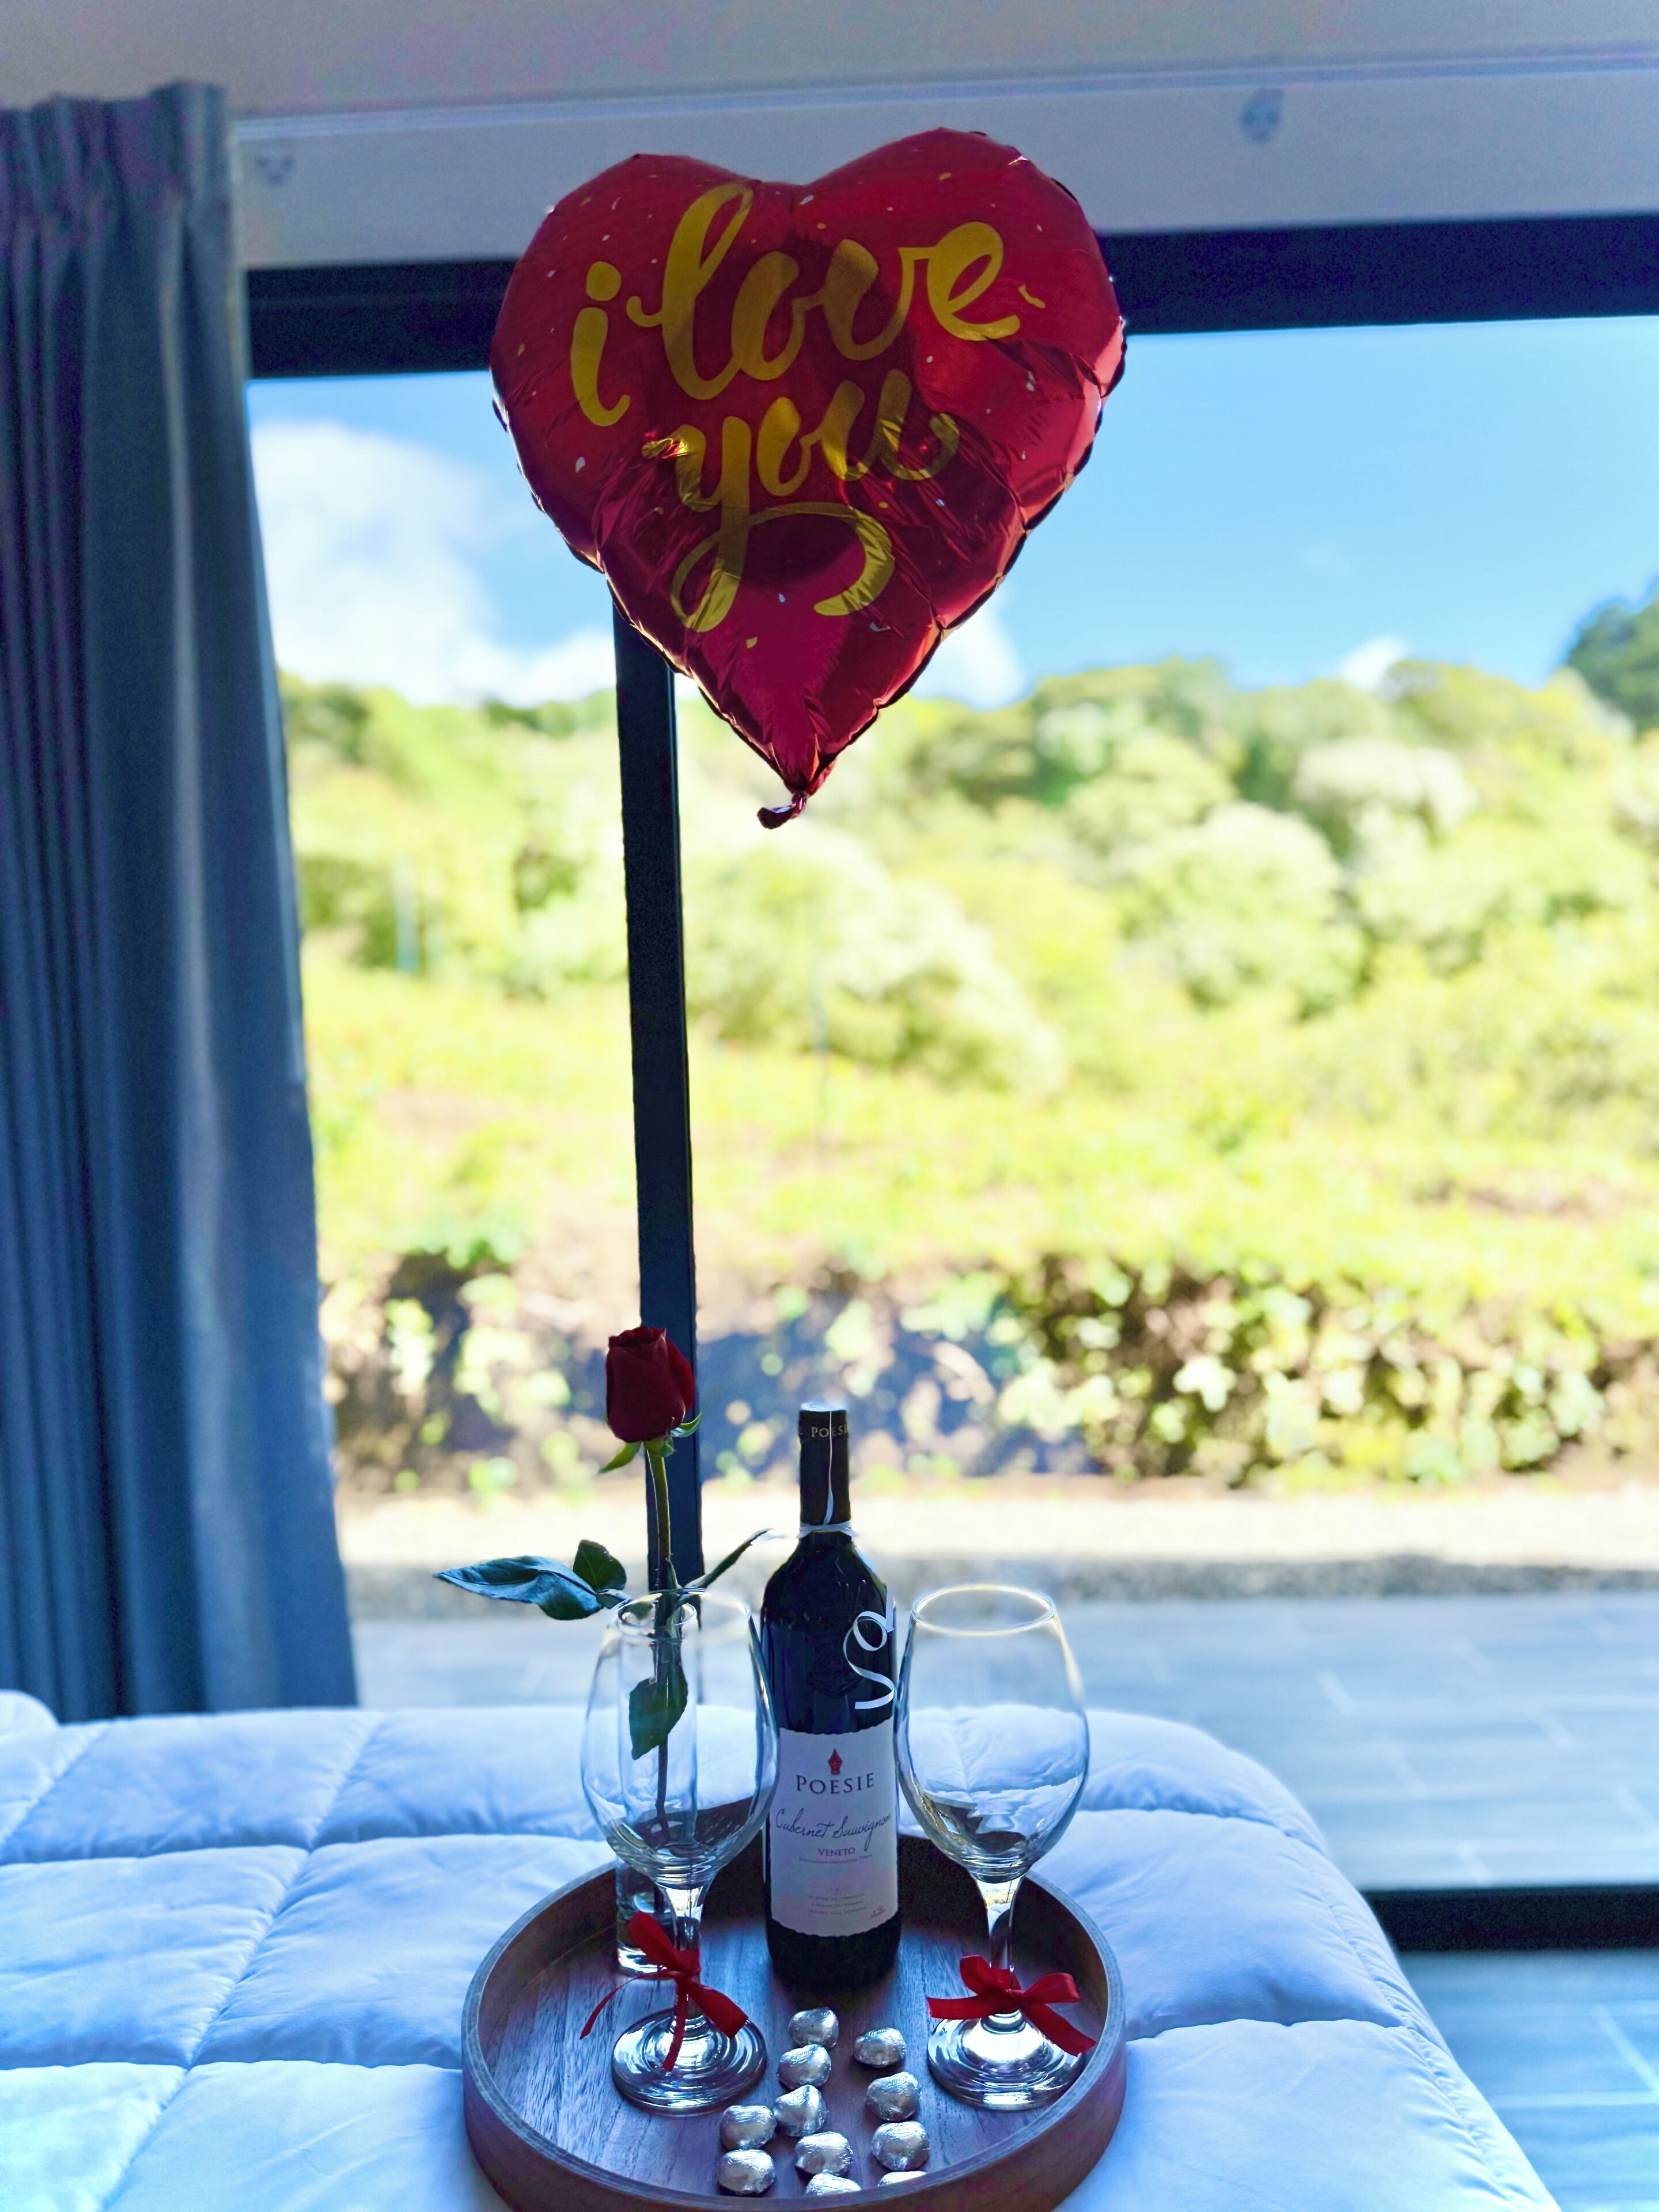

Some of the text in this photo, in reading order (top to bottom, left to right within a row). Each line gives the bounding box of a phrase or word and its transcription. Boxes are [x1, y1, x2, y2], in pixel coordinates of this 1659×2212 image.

[570, 183, 1021, 427] i love
[641, 369, 960, 632] you
[796, 1772, 874, 1795] POESIE
[775, 1808, 891, 1852] Cabernet Sauvignon
[818, 1847, 855, 1856] VENETO
